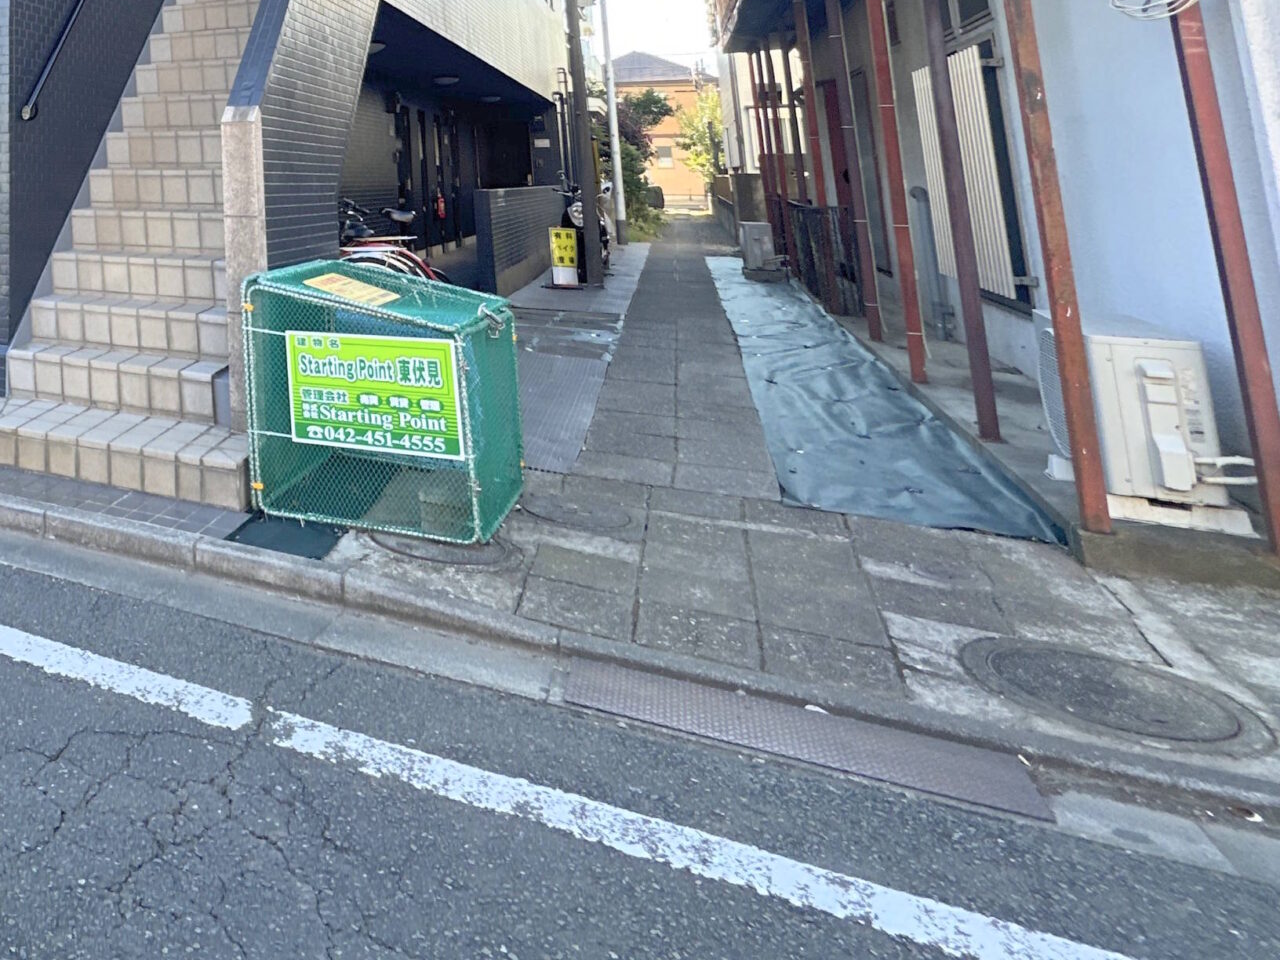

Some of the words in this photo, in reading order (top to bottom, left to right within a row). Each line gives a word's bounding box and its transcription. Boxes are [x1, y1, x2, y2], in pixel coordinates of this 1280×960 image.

[299, 354, 356, 381] Starting
[358, 358, 394, 381] Point
[397, 358, 442, 386] 東伏見
[319, 404, 394, 431] Starting
[398, 411, 448, 433] Point
[324, 425, 447, 453] 042-451-4555
